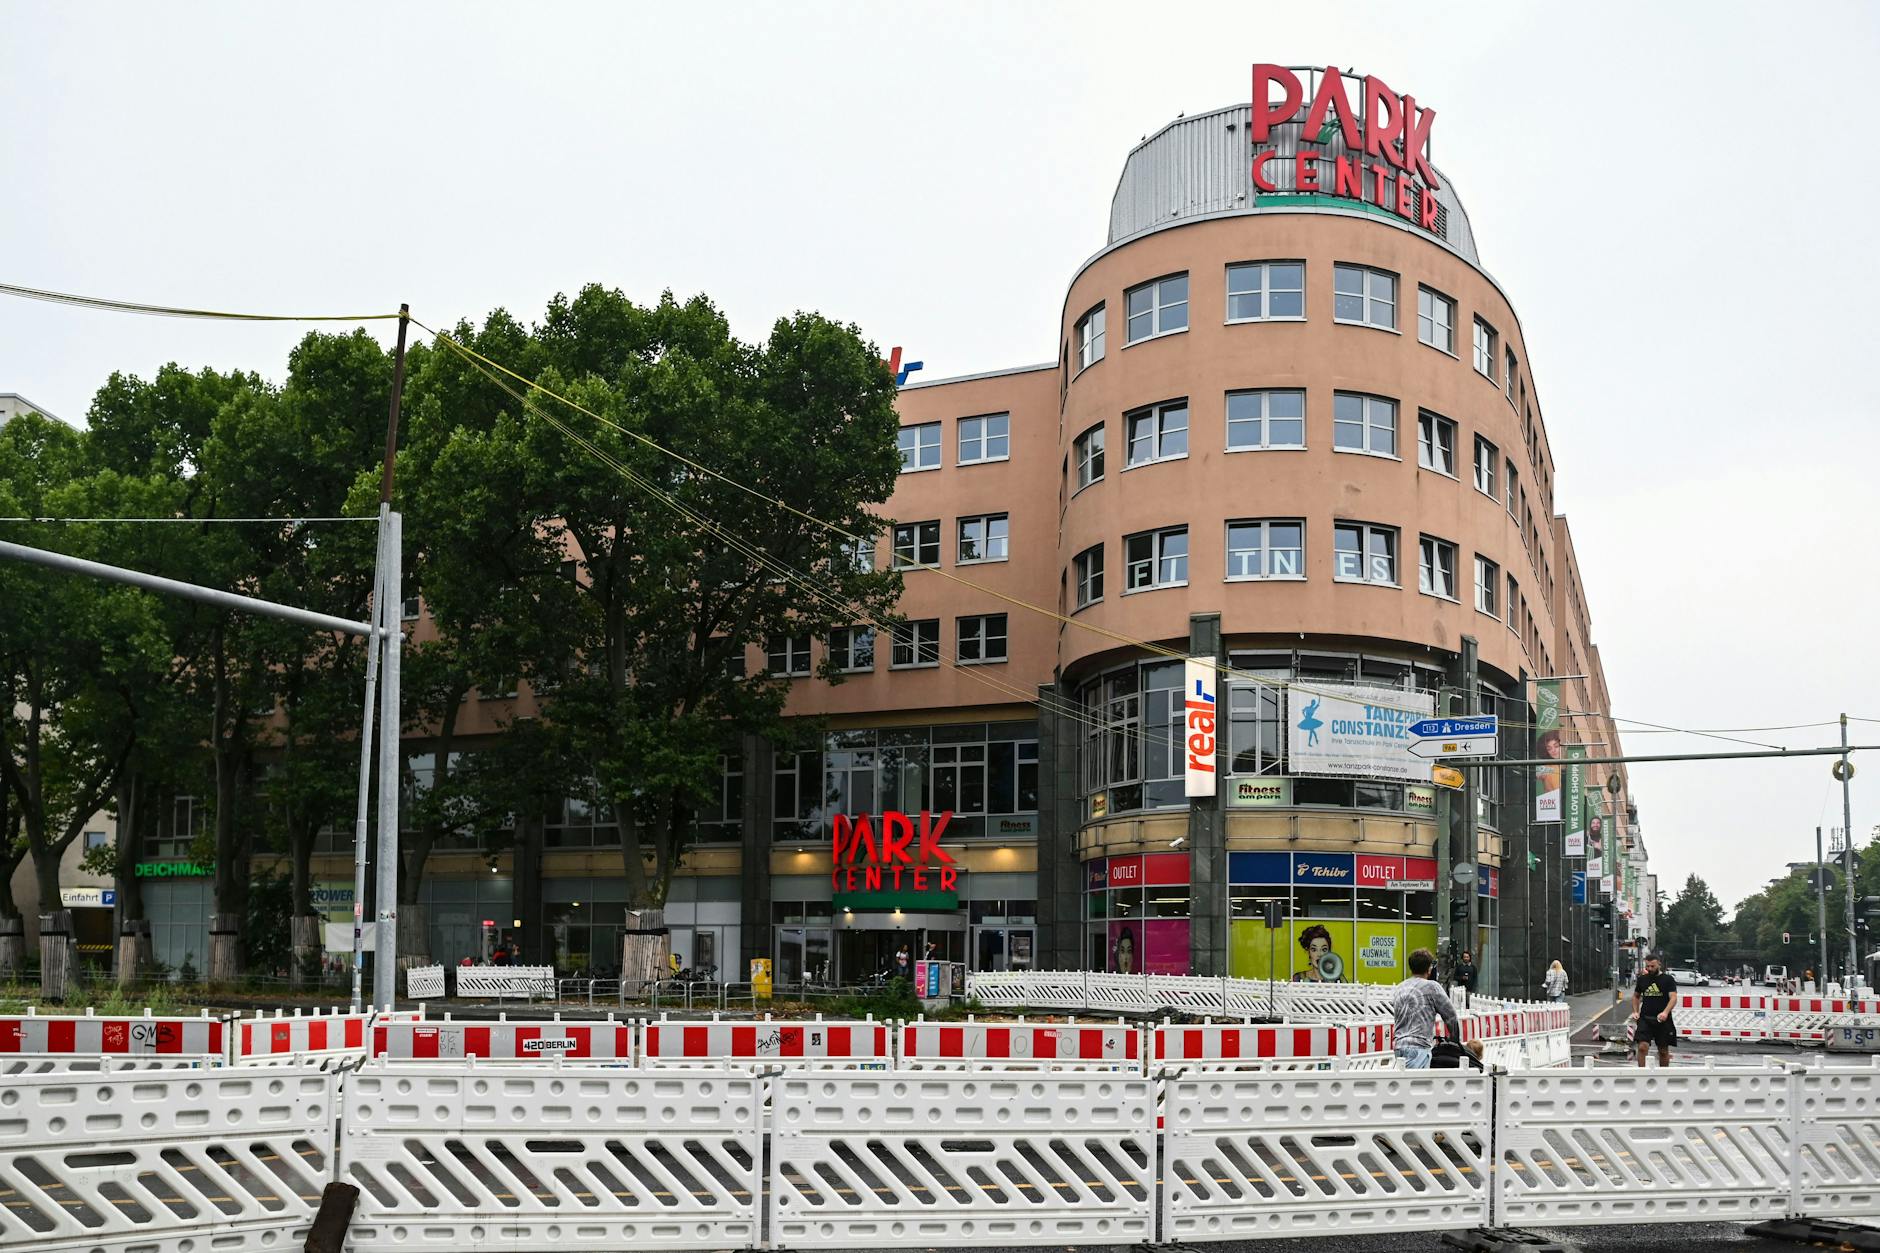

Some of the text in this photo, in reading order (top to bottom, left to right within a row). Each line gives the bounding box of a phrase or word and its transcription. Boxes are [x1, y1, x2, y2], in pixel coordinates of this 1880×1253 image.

[1252, 64, 1440, 190] PARK
[1252, 150, 1438, 233] CENTER
[1454, 723, 1490, 731] Dresden
[1328, 761, 1408, 774] www.tanzpark-constanze.de
[1571, 752, 1580, 830] WE LOVE SHOPPIG
[832, 810, 959, 865] PARK
[832, 865, 959, 892] CENTER
[1113, 865, 1138, 880] OUTLET
[1311, 866, 1350, 878] Tchibo
[1362, 865, 1396, 880] OUTLET
[63, 893, 99, 902] Einfahrt
[1371, 936, 1395, 947] GROSSE
[1361, 948, 1391, 958] AUSWAHL
[523, 1040, 576, 1050] 420 BERLIN
